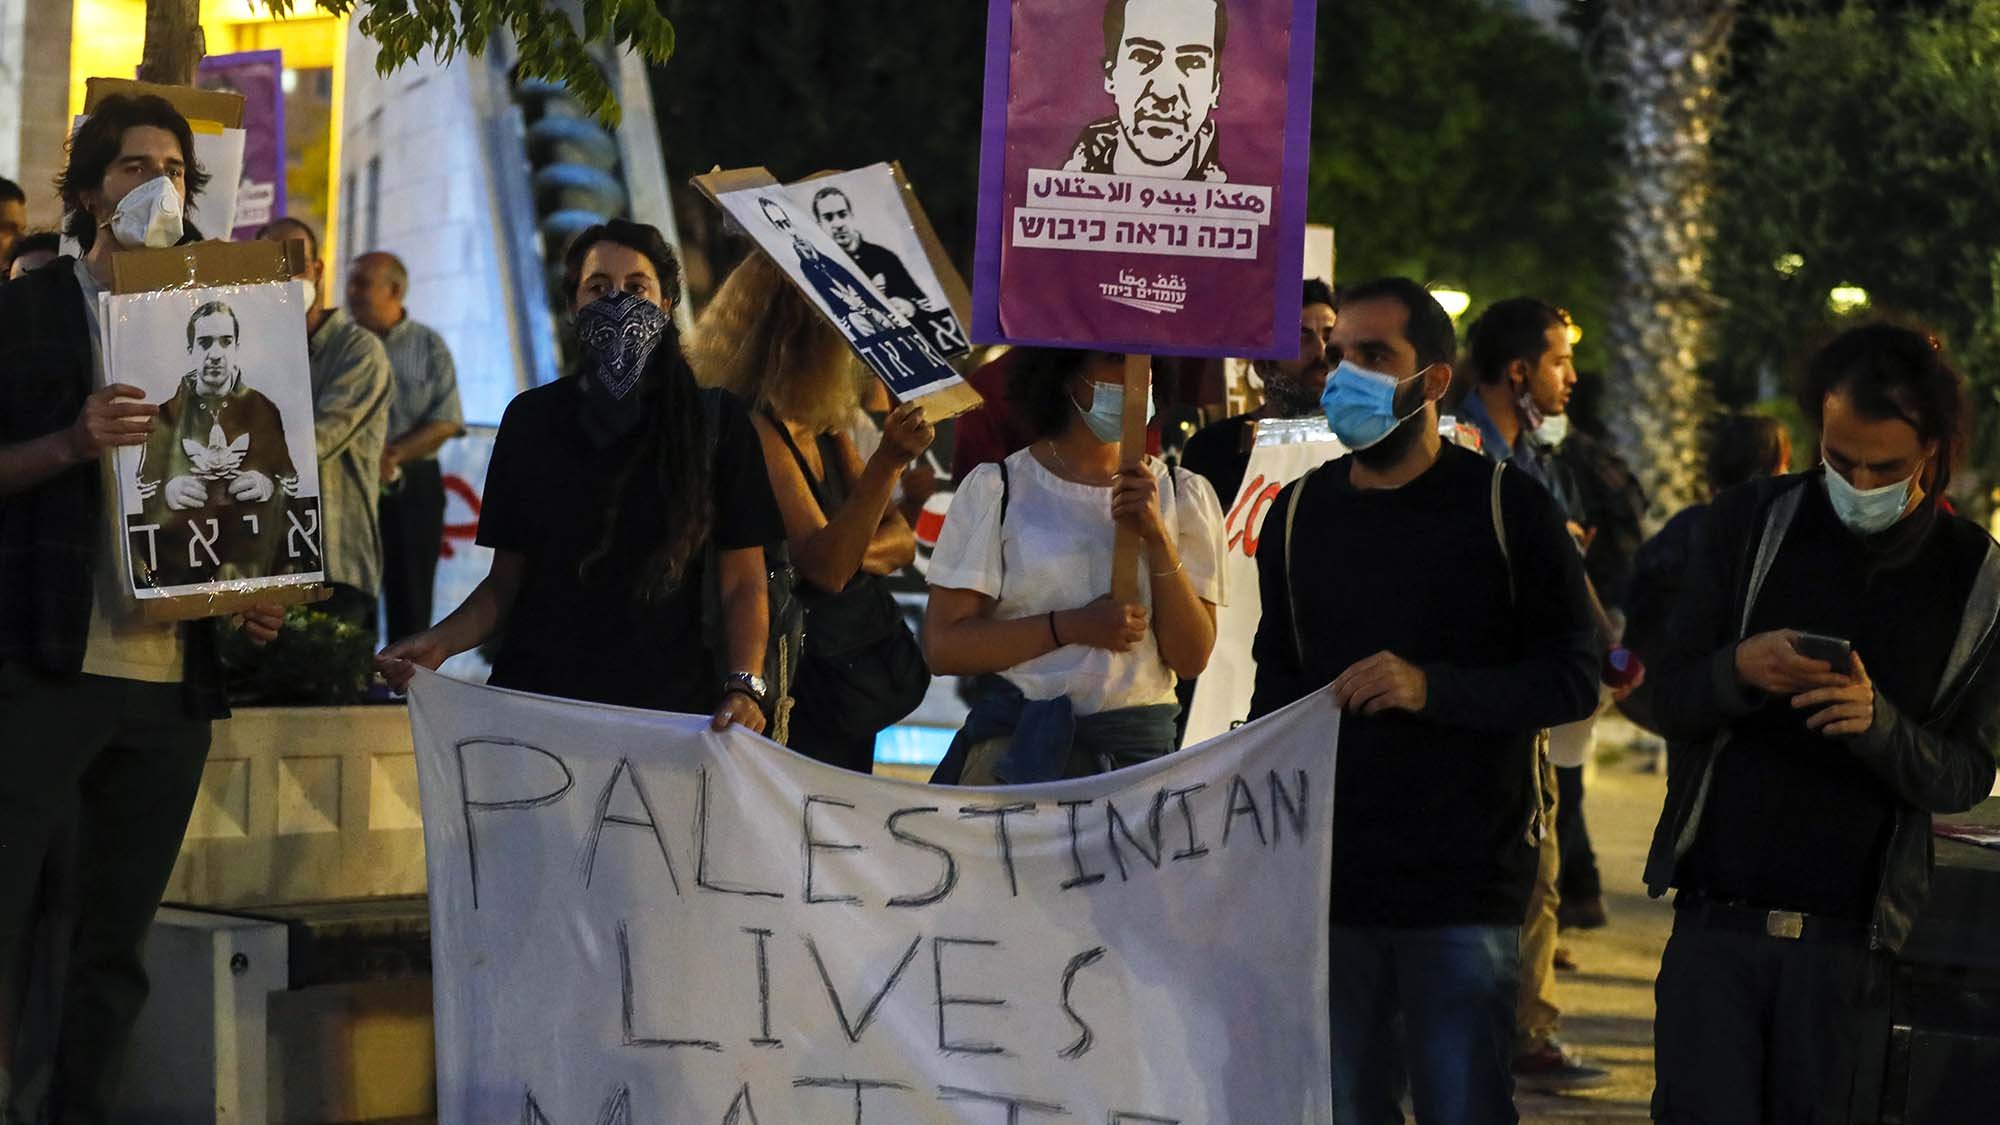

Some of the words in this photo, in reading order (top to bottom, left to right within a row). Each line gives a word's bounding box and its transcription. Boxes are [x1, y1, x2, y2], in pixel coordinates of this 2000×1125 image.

[1034, 176, 1132, 203] الاحتلال
[1139, 187, 1197, 214] يبدو
[1205, 189, 1265, 214] هكذا
[1018, 216, 1106, 242] כיבוש
[1116, 220, 1188, 248] נראה
[1197, 225, 1254, 250] ככה
[1098, 283, 1133, 298] ביחד
[1151, 272, 1187, 291] نقف
[1136, 287, 1187, 303] עומדים
[129, 508, 320, 572] איאד
[456, 736, 1311, 910] PALESTINIAN
[615, 918, 1109, 1060] LIVES
